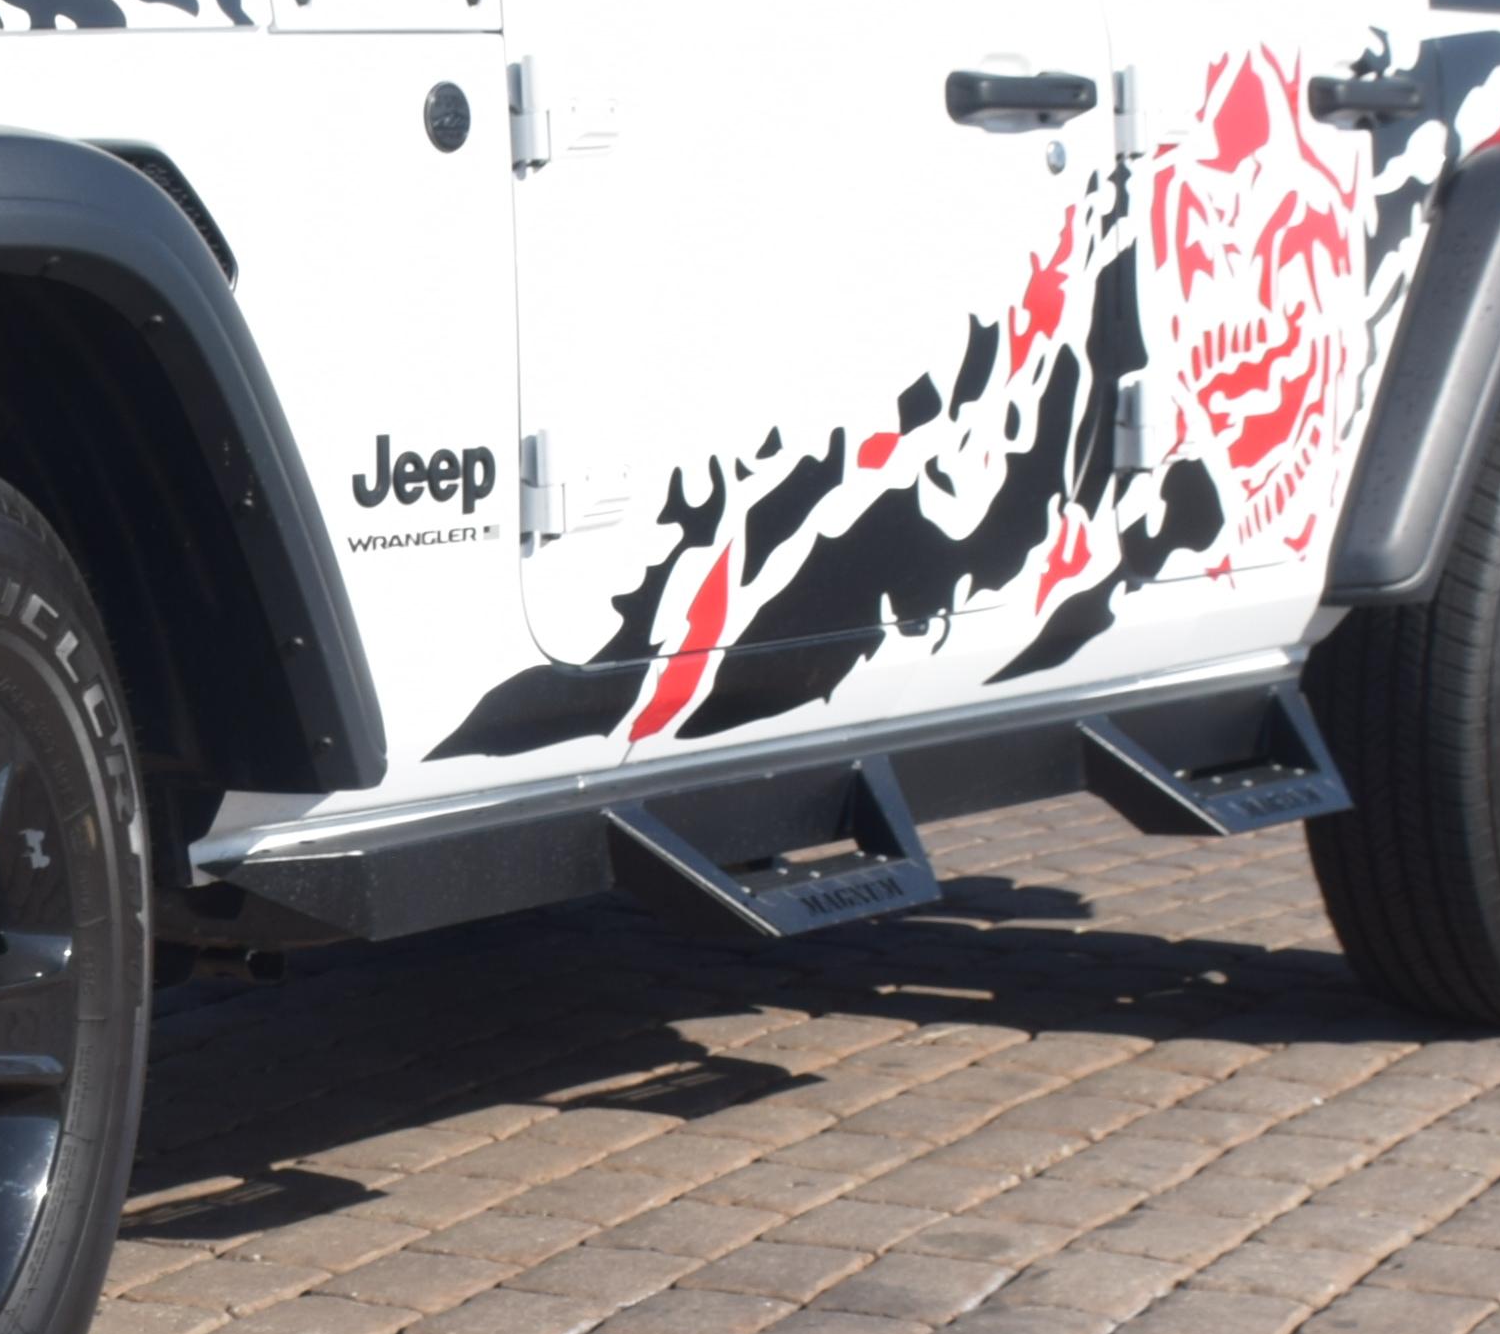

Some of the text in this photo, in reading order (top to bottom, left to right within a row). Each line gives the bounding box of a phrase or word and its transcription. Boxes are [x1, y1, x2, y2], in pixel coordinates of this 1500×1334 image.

[352, 434, 496, 515] Jeep
[347, 526, 477, 554] WRANGLER
[801, 876, 905, 918] MAGNUM
